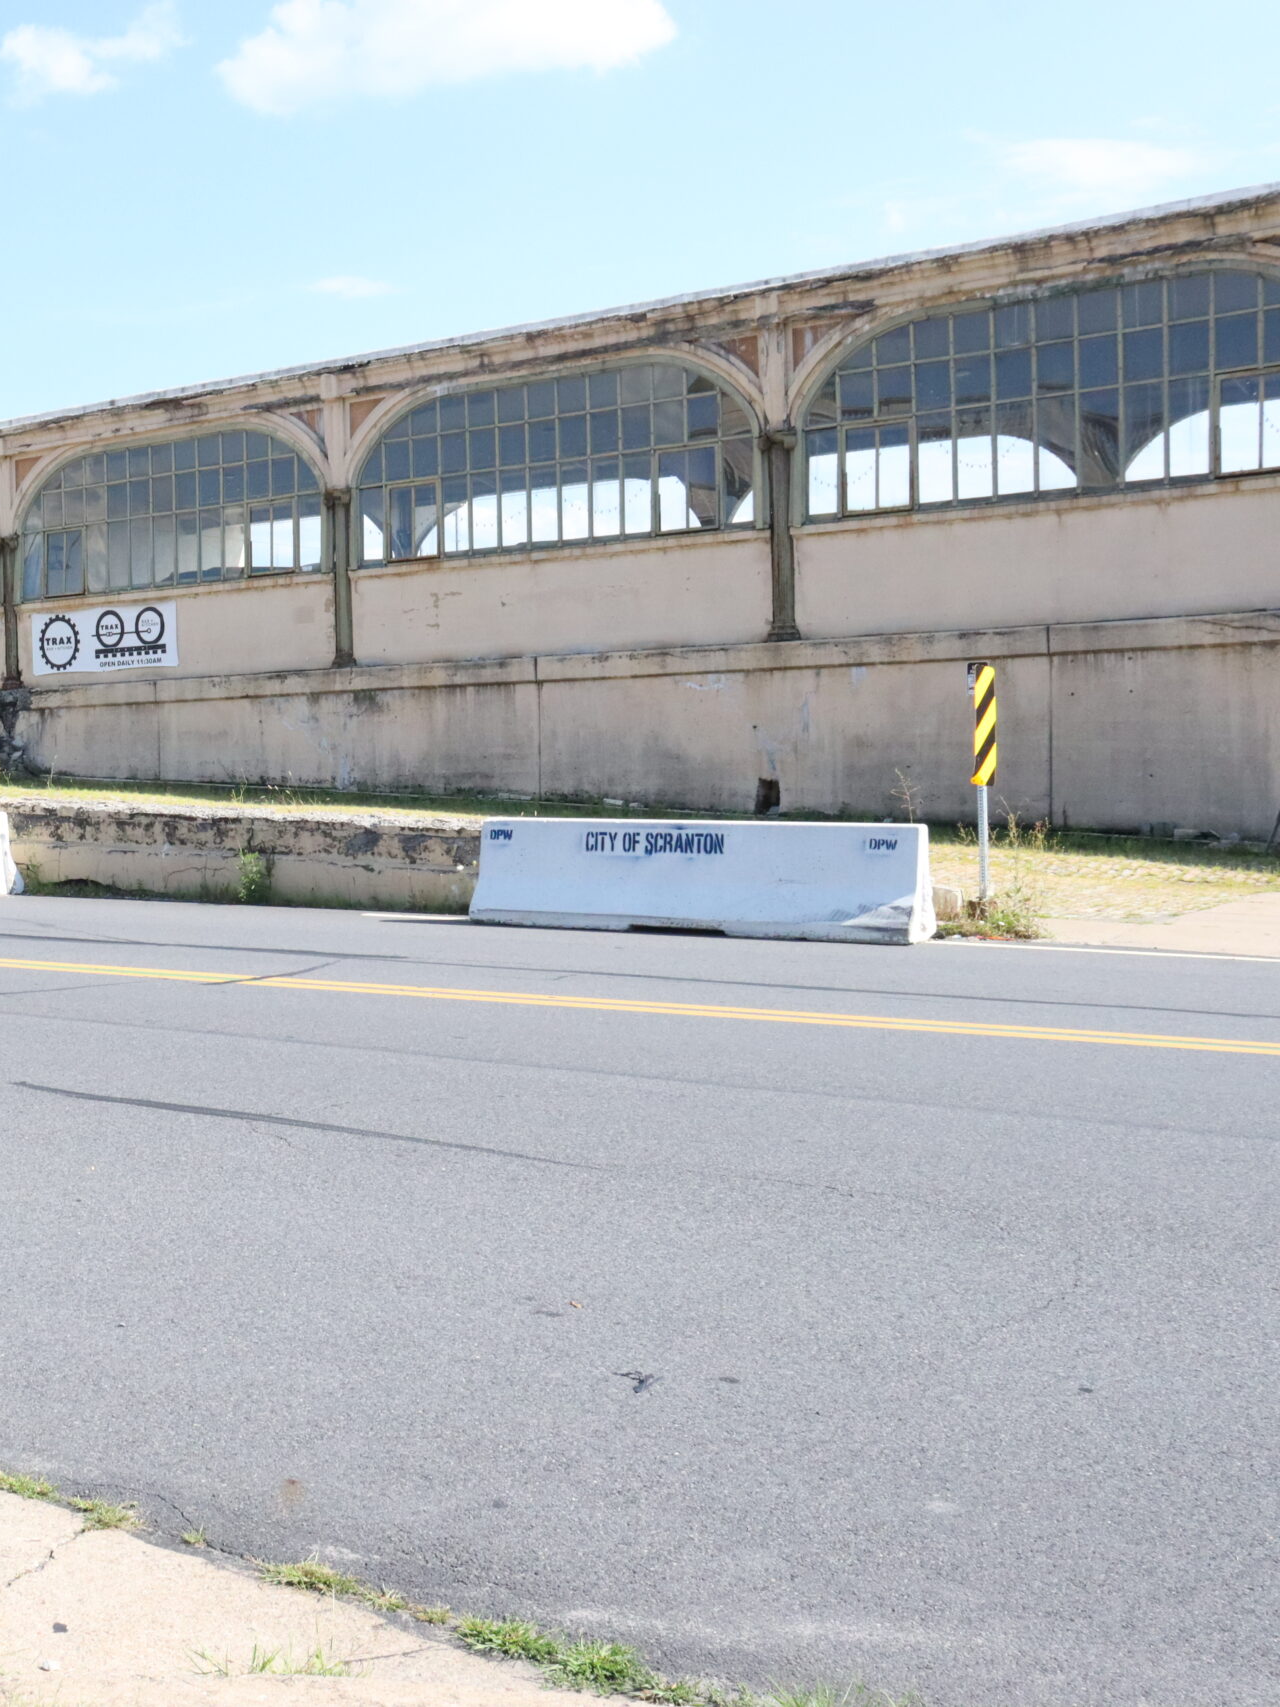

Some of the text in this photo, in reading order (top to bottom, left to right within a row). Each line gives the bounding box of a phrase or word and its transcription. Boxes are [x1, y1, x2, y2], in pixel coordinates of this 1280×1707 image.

[100, 623, 119, 631] TRAX
[45, 636, 72, 646] TRAX
[136, 657, 162, 665] 11:30AM
[489, 829, 514, 841] DPW
[585, 831, 725, 856] CITY OF SCRANTON
[869, 838, 898, 851] DPW
